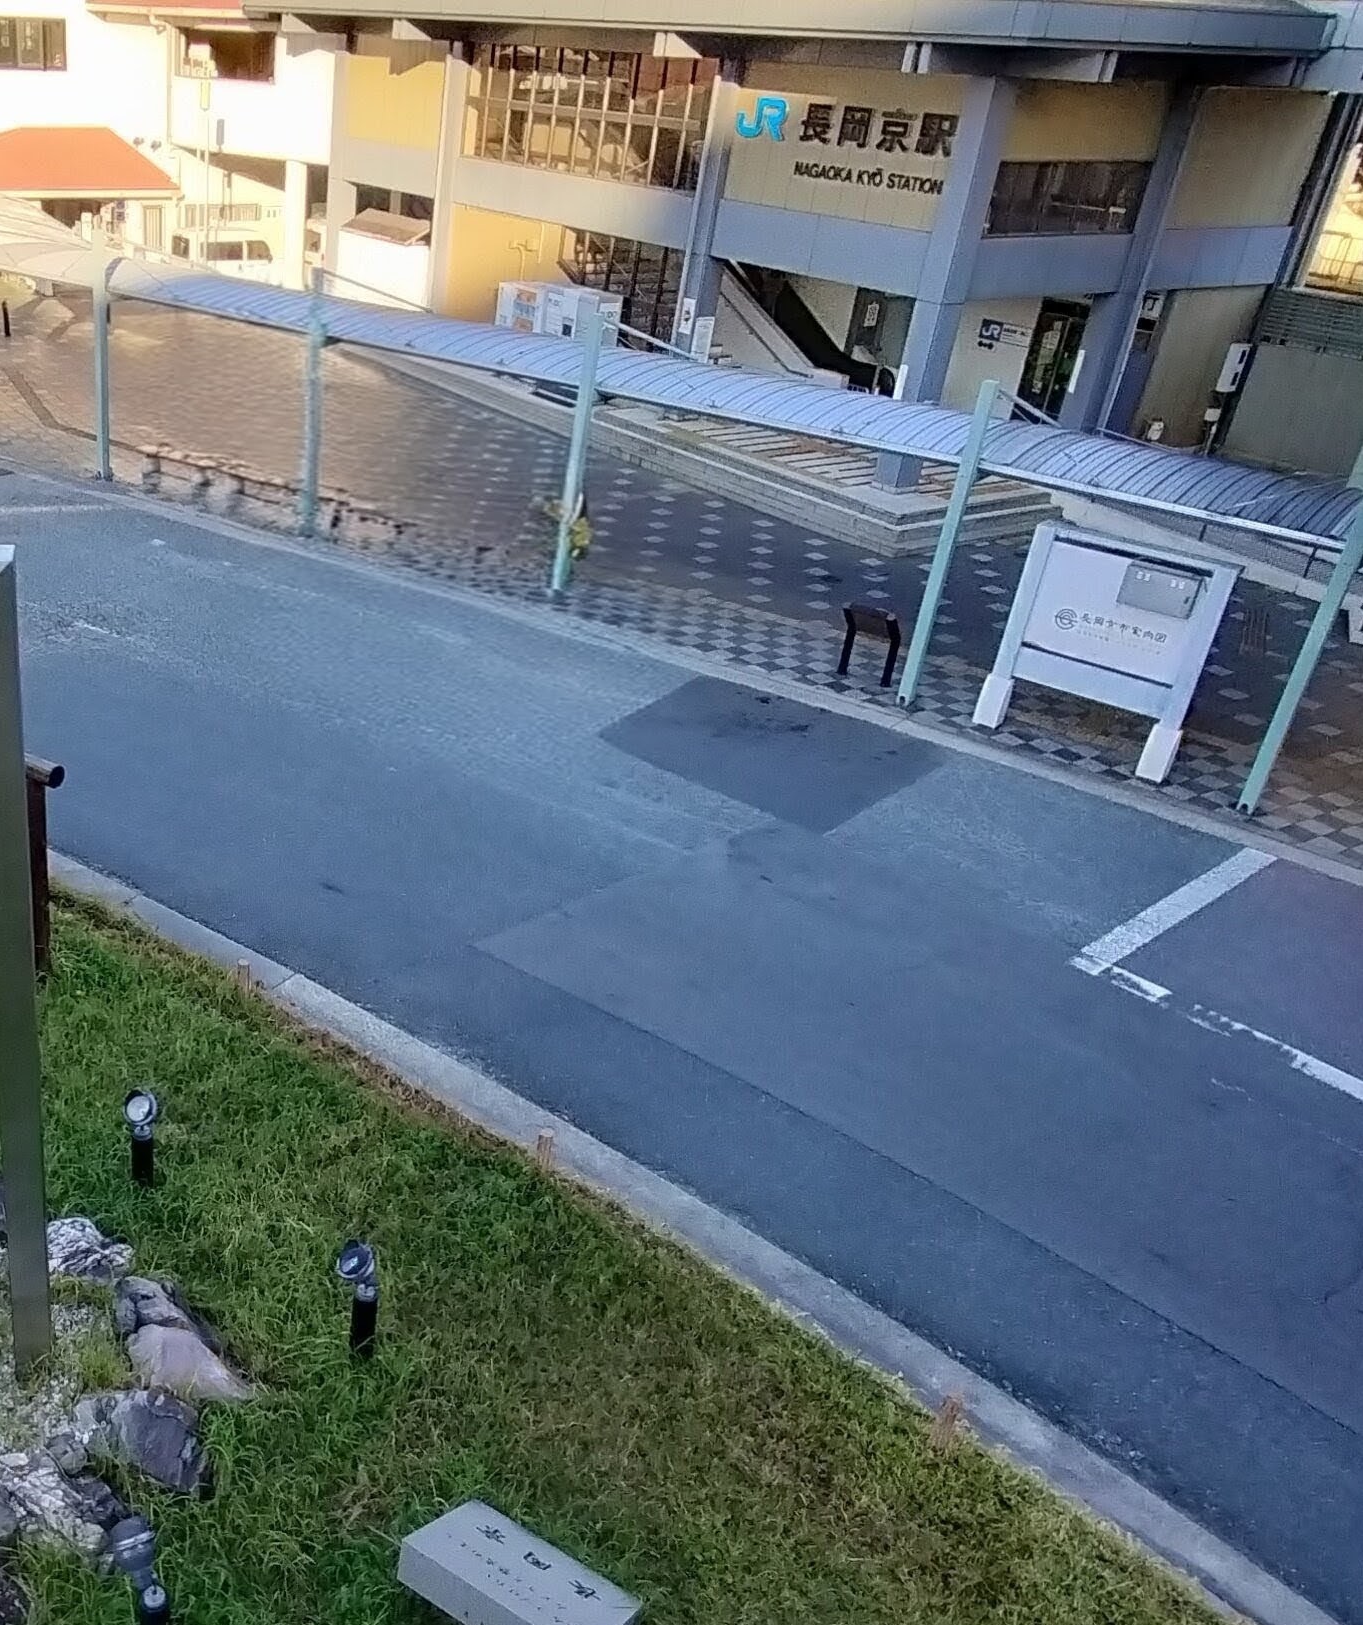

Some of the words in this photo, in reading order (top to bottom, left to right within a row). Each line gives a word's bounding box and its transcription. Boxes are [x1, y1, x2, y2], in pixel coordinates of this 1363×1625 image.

[736, 97, 789, 142] JR
[799, 103, 959, 157] 長岡京駅
[793, 161, 852, 184] NAGAOKA
[887, 173, 943, 195] STATION
